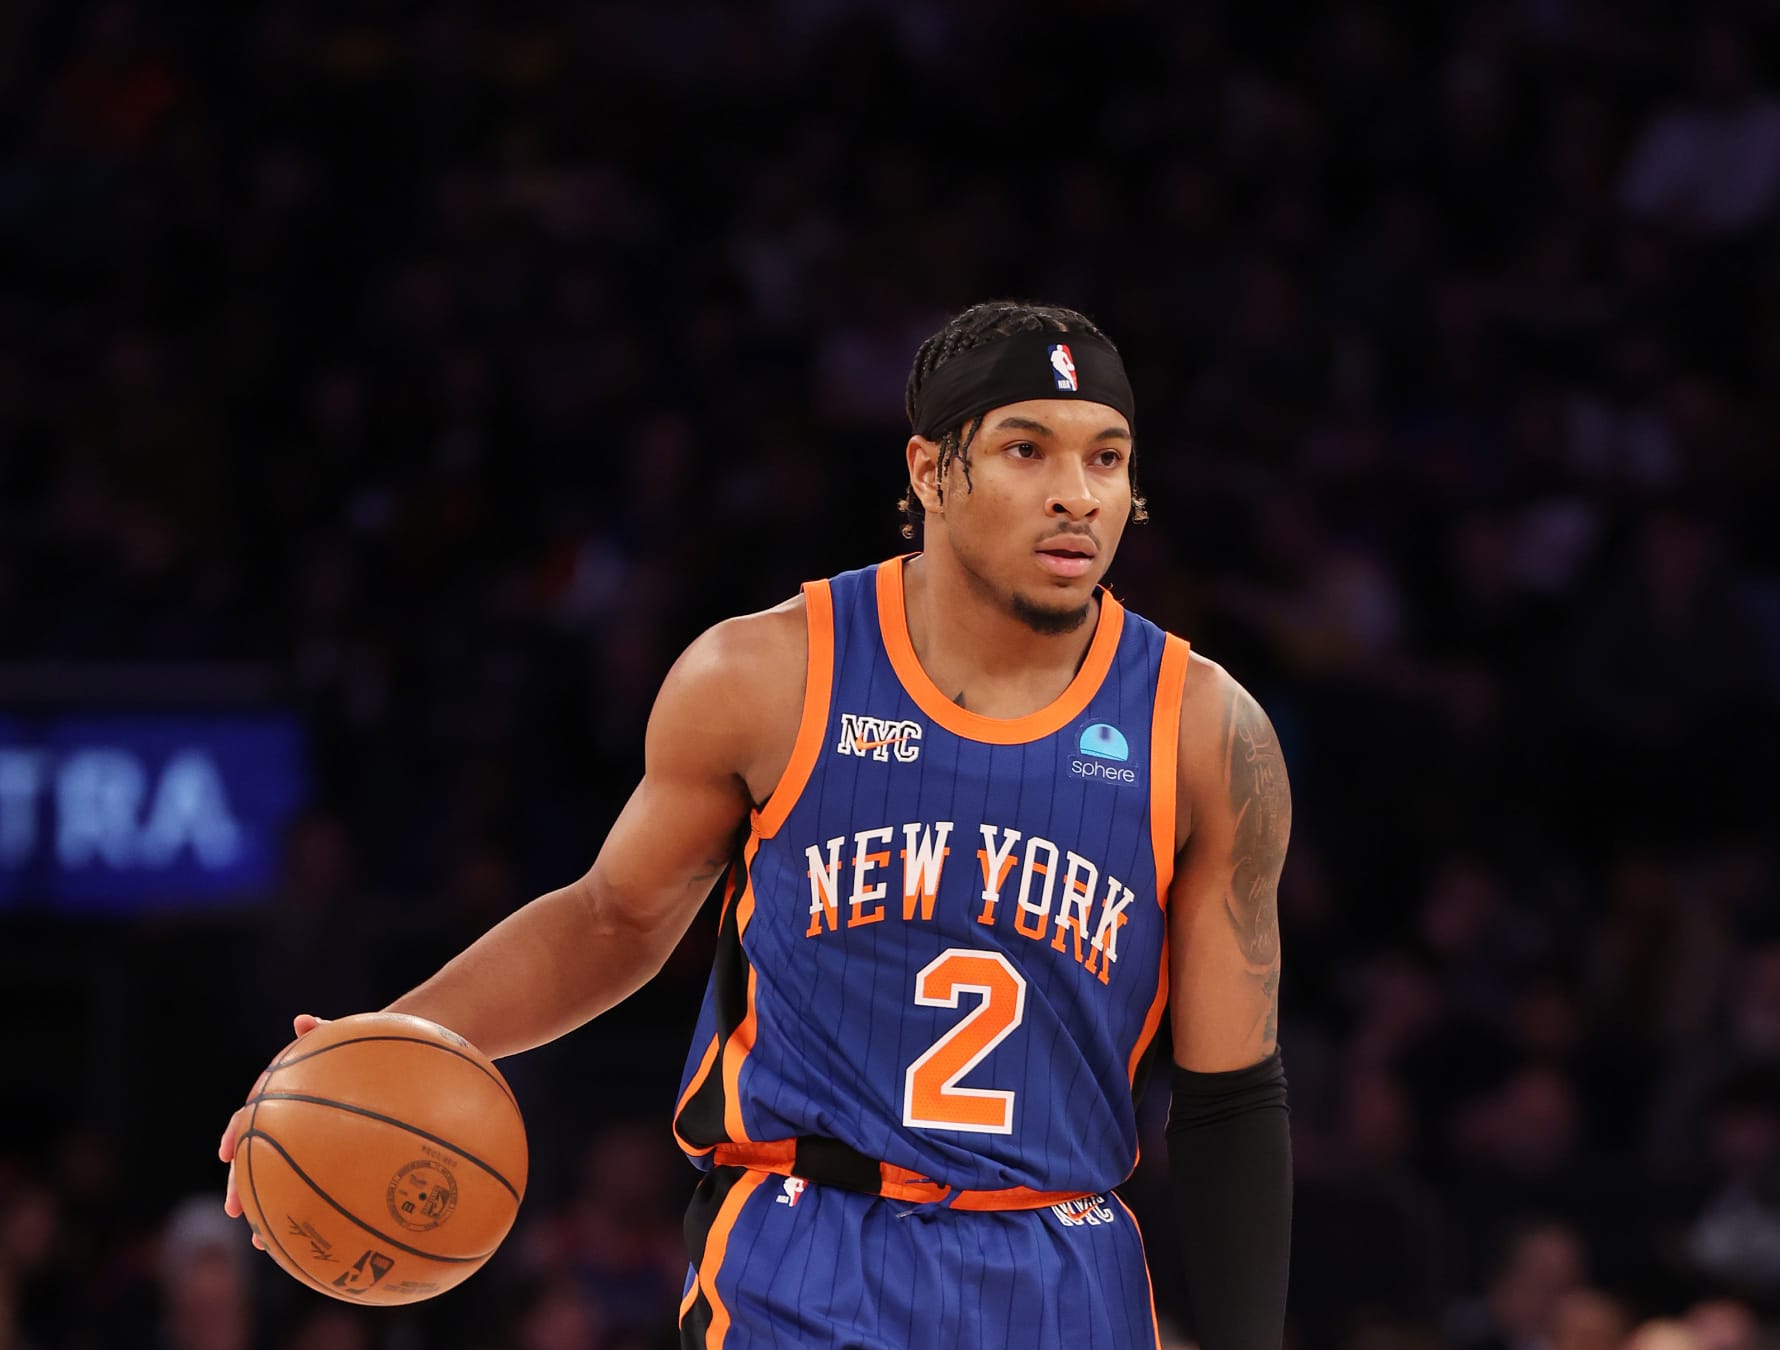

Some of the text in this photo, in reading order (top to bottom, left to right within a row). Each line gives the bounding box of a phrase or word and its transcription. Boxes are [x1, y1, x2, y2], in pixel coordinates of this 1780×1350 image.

[837, 713, 922, 763] NYC
[1071, 759, 1135, 783] sphere
[805, 821, 1135, 986] NEW YORK
[902, 948, 1027, 1135] 2
